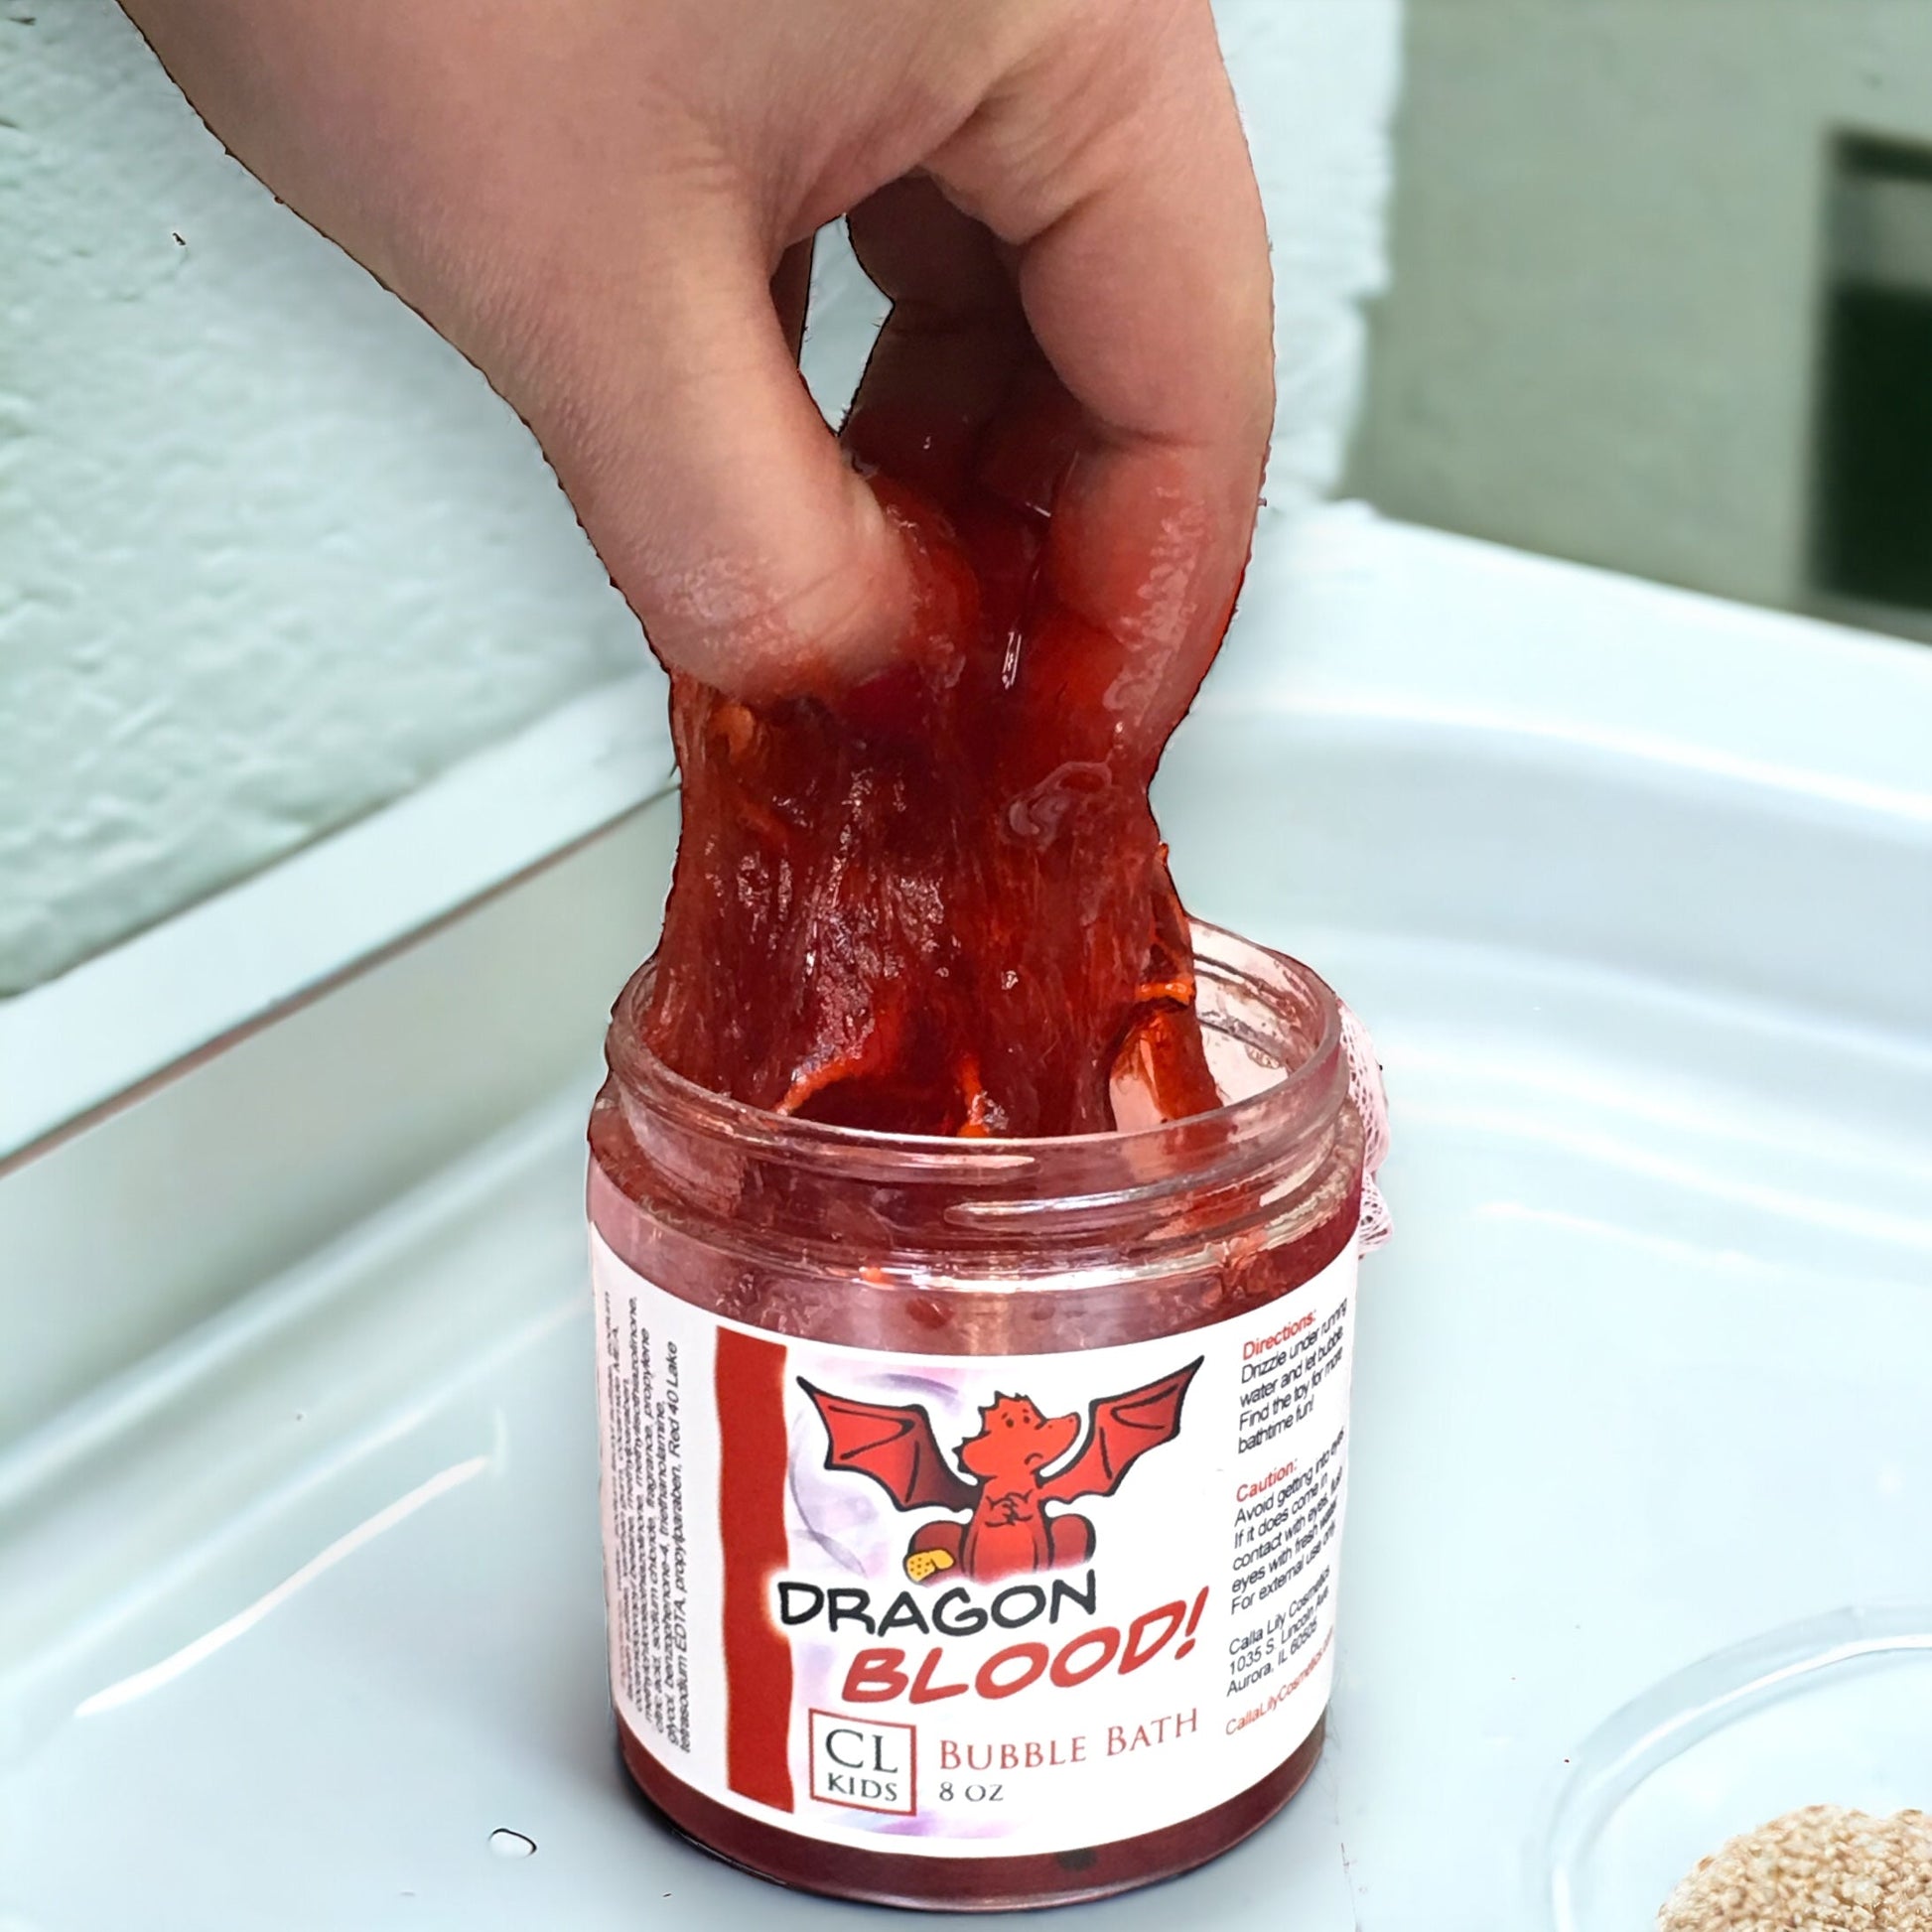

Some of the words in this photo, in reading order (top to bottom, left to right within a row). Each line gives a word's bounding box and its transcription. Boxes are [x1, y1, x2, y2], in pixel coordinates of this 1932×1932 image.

[1241, 1350, 1287, 1384] Drizzle
[1289, 1326, 1319, 1359] under
[1242, 1310, 1316, 1360] Directions:
[640, 1327, 654, 1420] propylene
[666, 1340, 678, 1388] Lake
[1240, 1378, 1278, 1408] water
[1281, 1360, 1303, 1389] and
[1305, 1351, 1316, 1372] let
[666, 1389, 679, 1416] 40
[1238, 1414, 1294, 1454] bathtime
[1296, 1394, 1314, 1423] fun!
[1239, 1403, 1269, 1431] Find
[1272, 1393, 1292, 1416] the
[1294, 1381, 1310, 1402] toy
[1311, 1368, 1323, 1389] for
[668, 1417, 681, 1458] Red
[1234, 1491, 1275, 1527] Avoid
[1277, 1466, 1313, 1508] getting
[1236, 1457, 1298, 1502] Caution:
[1233, 1532, 1282, 1571] contact
[1285, 1515, 1306, 1542] with
[1234, 1529, 1244, 1549] If
[1247, 1526, 1255, 1543] it
[1258, 1508, 1289, 1537] does
[1292, 1482, 1319, 1515] come
[1231, 1566, 1266, 1593] eyes
[1269, 1548, 1293, 1573] with
[1295, 1524, 1317, 1554] fresh
[1231, 1592, 1256, 1615] For
[1259, 1554, 1305, 1600] external
[1306, 1541, 1322, 1565] use
[777, 1569, 1097, 1638] DRAGON
[841, 1585, 1209, 1705] BLOOD!
[1229, 1628, 1263, 1655] Calla
[1267, 1612, 1287, 1635] Lily
[1230, 1645, 1262, 1675] 1035
[1278, 1649, 1288, 1666] IL
[825, 1728, 898, 1774] CL
[939, 1735, 1087, 1772] BUBBLE
[1106, 1708, 1198, 1757] BATH
[827, 1771, 898, 1802] KIDS
[939, 1782, 955, 1802] 8
